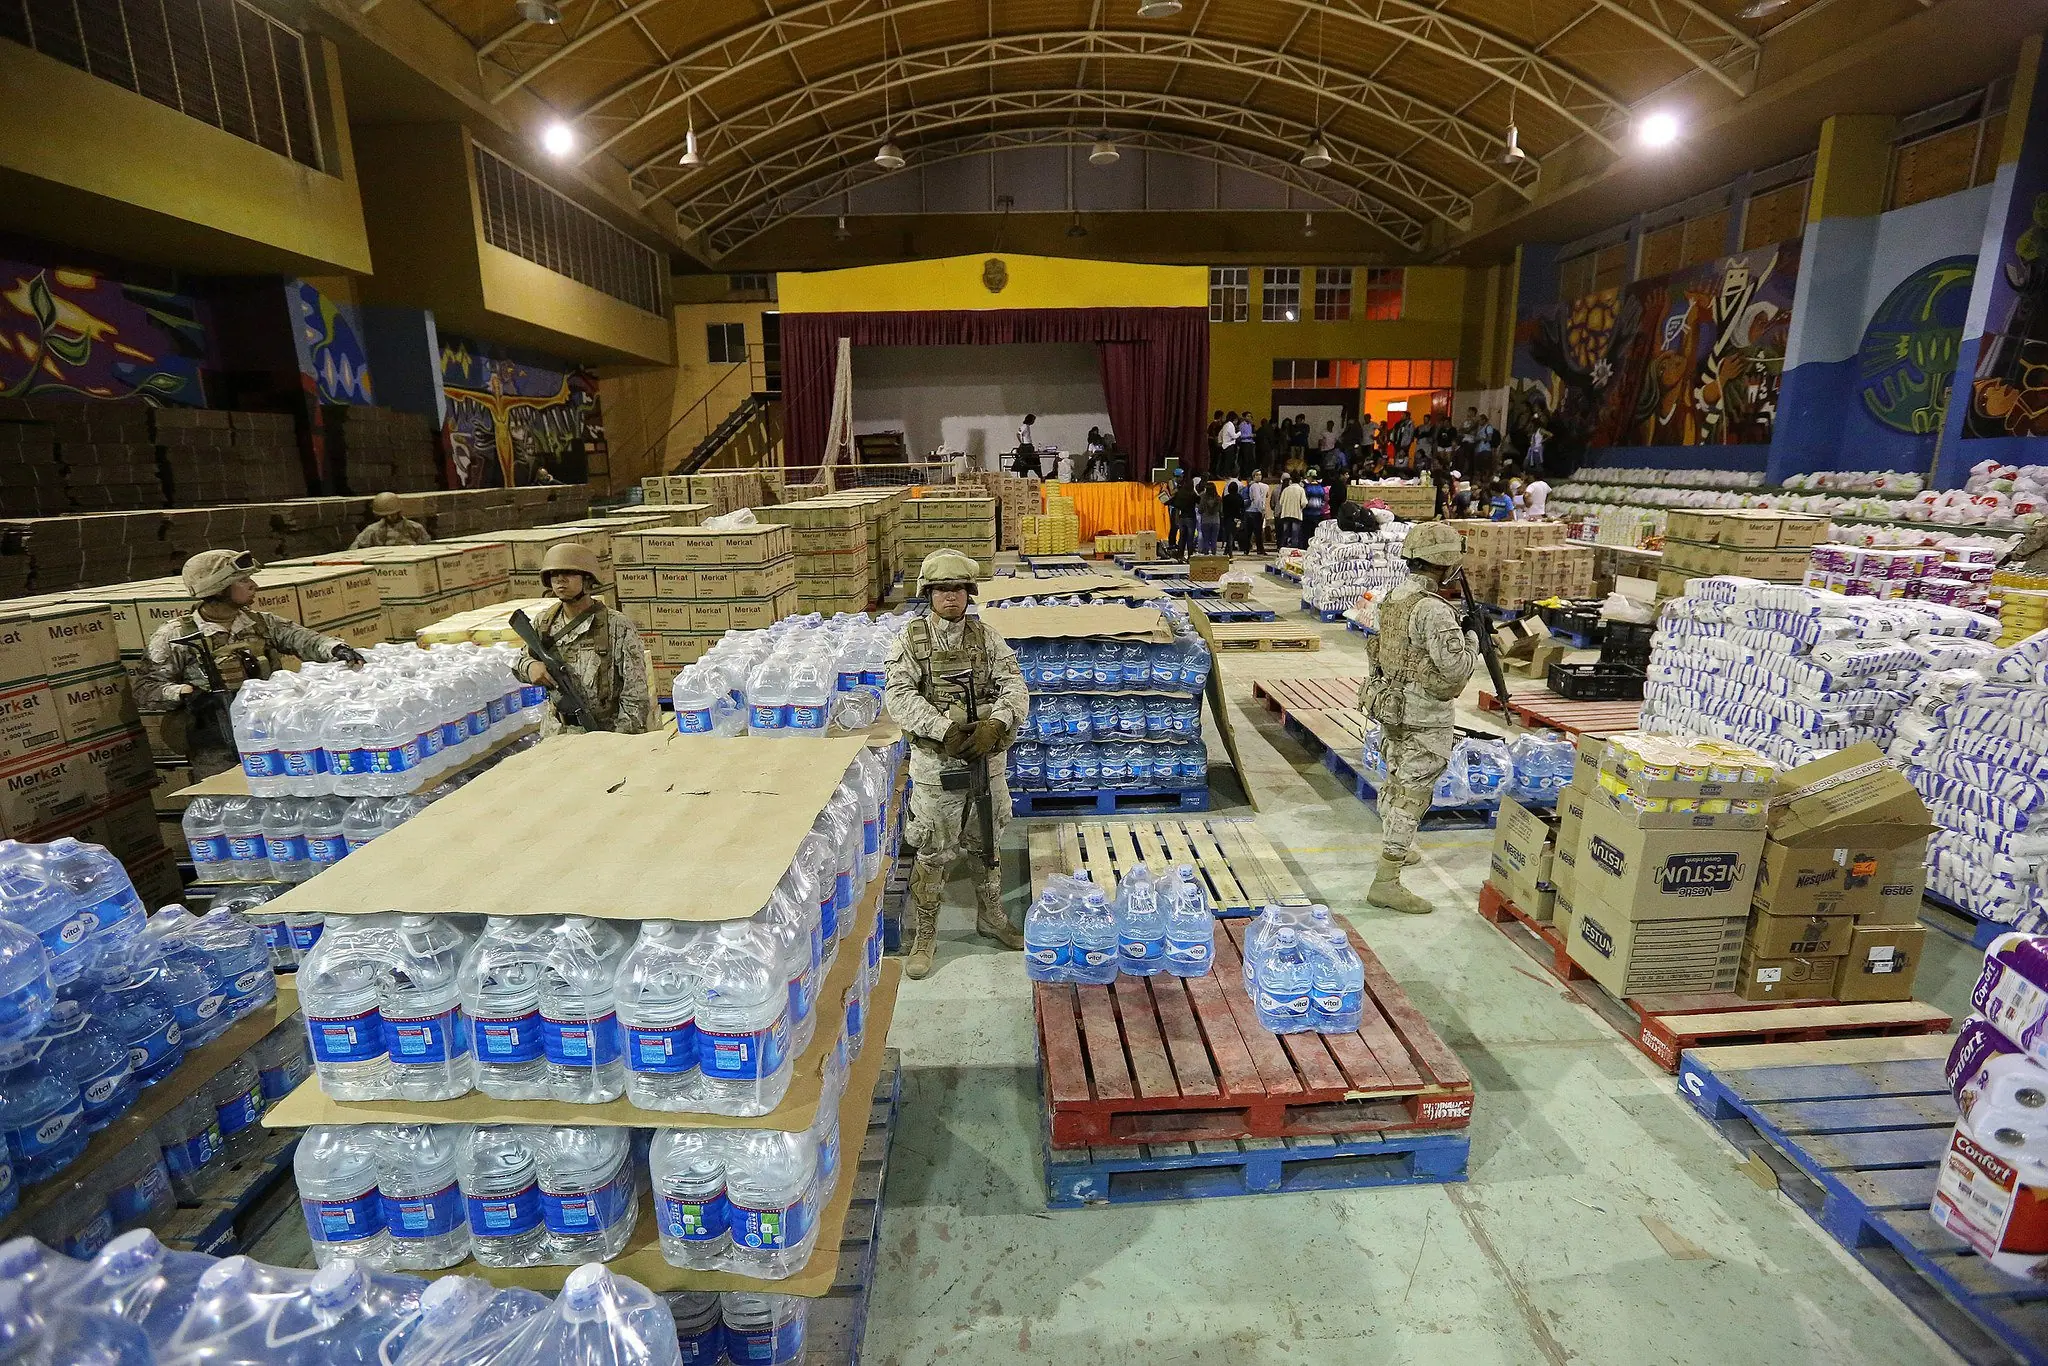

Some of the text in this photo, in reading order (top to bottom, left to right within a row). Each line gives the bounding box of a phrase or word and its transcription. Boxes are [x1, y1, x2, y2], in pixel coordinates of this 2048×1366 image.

[648, 539, 675, 547] Merkat
[686, 539, 713, 547] Merkat
[346, 577, 372, 590] Merkat
[514, 579, 541, 587] Merkat
[622, 573, 649, 581] Merkat
[662, 573, 689, 581] Merkat
[701, 573, 728, 581] Merkat
[306, 586, 335, 599] Merkat
[258, 594, 290, 607] Merkat
[149, 608, 191, 619] Merka
[656, 606, 683, 614] Merkat
[695, 607, 722, 615] Merkat
[734, 605, 761, 614] Merkat
[48, 619, 104, 640] Merkat
[352, 623, 378, 637] Merkat
[668, 639, 695, 647] Merkat
[67, 682, 121, 706] Merkat
[7, 762, 67, 792] Merkat
[1588, 838, 1628, 876] NESTUM
[1653, 864, 1746, 884] NESTUM
[1796, 868, 1838, 889] Nesquik
[62, 924, 81, 940] vital
[1579, 918, 1617, 958] NESTUM
[1129, 946, 1144, 954] vital
[1190, 948, 1205, 956] vital
[1088, 954, 1102, 962] vital
[237, 976, 257, 989] vital
[199, 1000, 218, 1014] vital
[1293, 1000, 1308, 1008] vital
[1323, 999, 1340, 1007] vital
[1948, 1030, 1987, 1088] onfort
[1976, 1069, 1989, 1090] 30
[88, 1080, 111, 1099] vital
[40, 1120, 64, 1139] vital
[1956, 1136, 2012, 1181] Confort
